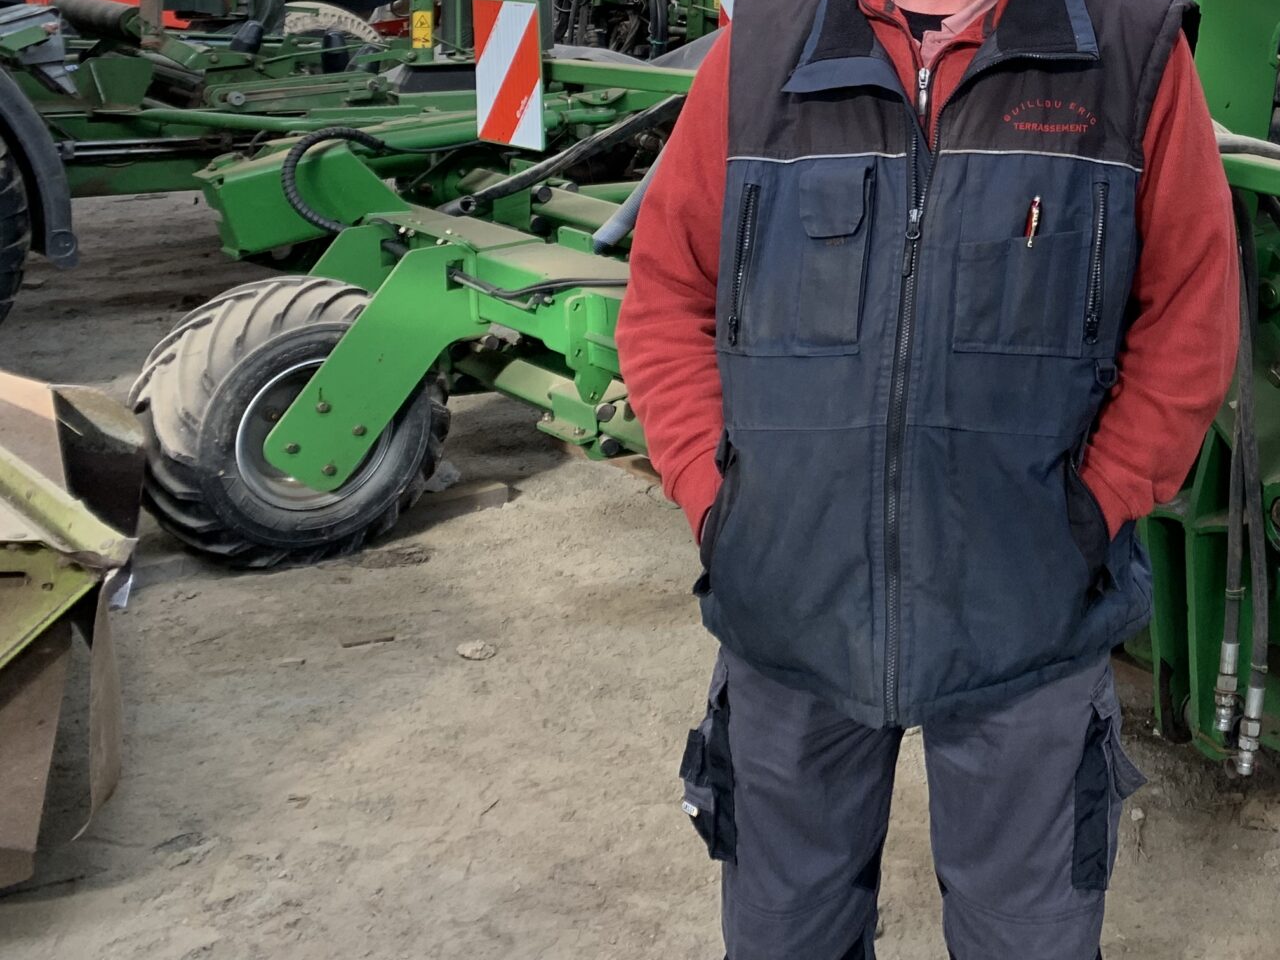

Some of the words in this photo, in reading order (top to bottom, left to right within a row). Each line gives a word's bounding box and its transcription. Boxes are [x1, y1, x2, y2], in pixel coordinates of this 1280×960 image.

[1003, 99, 1062, 122] GUILLOU
[1069, 102, 1097, 125] ERIC
[1013, 122, 1088, 133] TERRASSEMENT
